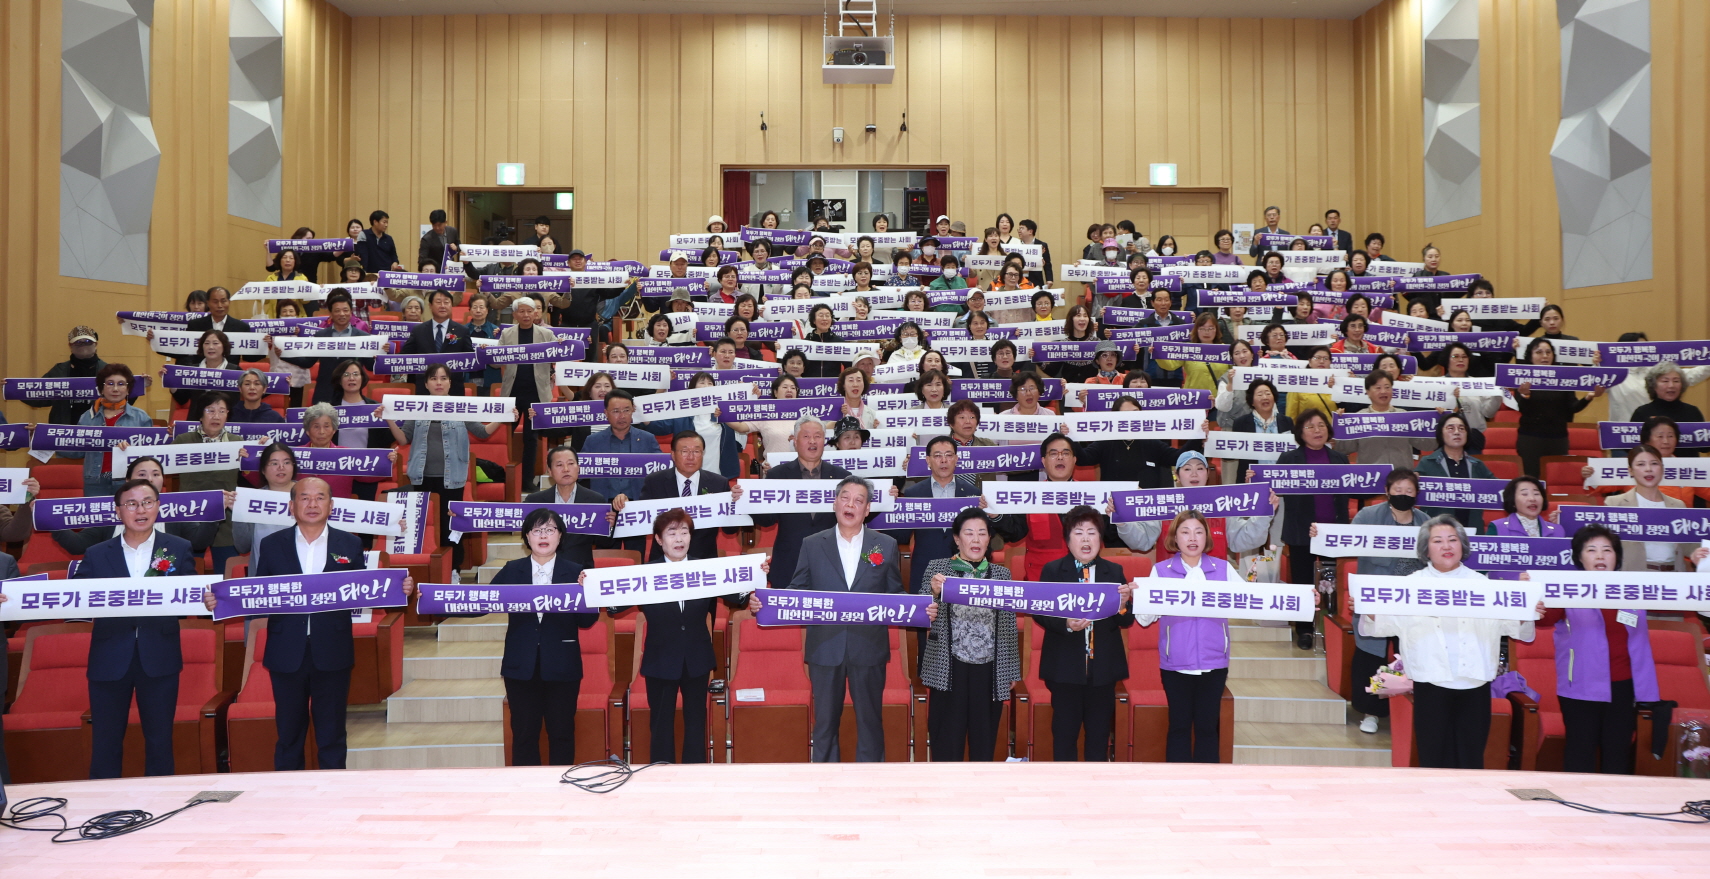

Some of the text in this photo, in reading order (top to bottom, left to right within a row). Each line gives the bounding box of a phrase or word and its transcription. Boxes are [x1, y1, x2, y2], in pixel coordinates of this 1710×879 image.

[493, 249, 523, 257] 존중받는
[390, 278, 458, 288] 대한민국의 태안!
[538, 280, 562, 289] 태안!
[1261, 292, 1288, 301] 태안!
[833, 303, 848, 311] 사회
[1482, 305, 1517, 313] 존중받는
[1522, 304, 1540, 313] 사회
[757, 327, 785, 339] 태안!
[1311, 332, 1327, 340] 사회
[160, 337, 258, 349] 모두가 사회
[284, 341, 379, 350] 모두가 존중받는 사회
[486, 348, 506, 356] 모두가
[493, 344, 574, 362] 대한민국의 정원 태안!
[817, 346, 850, 354] 존중받는
[1048, 350, 1081, 358] 대한민국의
[446, 358, 476, 369] 태안!
[674, 352, 702, 364] 태안!
[1617, 354, 1678, 363] 대한민국의 정원
[175, 369, 197, 377] 모두가
[182, 377, 224, 386] 대한민국의
[1580, 374, 1616, 387] 태안!
[26, 388, 72, 397] 대한민국의
[961, 383, 1002, 392] 모두가 행복한
[643, 400, 675, 414] 모두가
[728, 391, 749, 401] 사회
[1098, 393, 1119, 401] 모두가
[1149, 391, 1200, 407] 정원 태안!
[394, 401, 504, 413] 모두가 존중받는 사회
[544, 405, 590, 415] 모두가 행복한
[729, 404, 775, 414] 모두가 행복한
[551, 414, 594, 423] 대한민국의
[737, 405, 833, 421] 대한민국의 정원 태안!
[887, 417, 917, 427] 모두가
[1077, 419, 1194, 432] 모두가 존중받는 사회
[1338, 417, 1385, 426] 모두가 행복한
[77, 429, 102, 437] 행복한
[1004, 422, 1047, 433] 존중받는
[1346, 424, 1408, 434] 대한민국의 정원
[55, 434, 169, 447] 대한민국의 태안!
[267, 429, 304, 443] 태안!
[886, 436, 906, 447] 사회
[1216, 440, 1248, 451] 모두가
[176, 452, 230, 466] 존중받는
[316, 456, 379, 471] 정원 태안!
[595, 457, 619, 465] 행복한
[873, 456, 895, 468] 사회
[977, 452, 1035, 469] 정원 태안!
[625, 467, 642, 475] 정원
[1263, 470, 1315, 478] 모두가 행복한
[1272, 472, 1380, 488] 대한민국의 정원 태안!
[1419, 482, 1471, 493] 모두가 행복한
[749, 490, 790, 503] 모두가
[996, 492, 1095, 506] 모두가 존중받는
[1126, 494, 1184, 508] 모두가 행복한
[1215, 492, 1259, 512] 태안!
[1426, 492, 1497, 503] 대한민국의 정원
[53, 503, 87, 516] 모두가
[160, 499, 207, 518] 태안!
[464, 508, 523, 518] 모두가 행복한
[362, 511, 389, 526] 사회
[1575, 512, 1638, 522] 모두가 행복한
[1646, 525, 1669, 535] 정원
[1325, 535, 1416, 551] 모두가 존중받
[1470, 542, 1529, 553] 모두가 행복한
[1478, 554, 1557, 566] 대한민국의 정원
[600, 567, 752, 595] 모두가 존중받는 사회
[230, 582, 302, 599] 모두가 행복한
[242, 578, 391, 609] 대한민국의 정원 태안!
[434, 590, 499, 601] 모두가 행복한
[959, 584, 1024, 597] 모두가 행복한
[1545, 584, 1597, 598] 모두가
[1605, 585, 1677, 600] 존중받는
[21, 592, 81, 609] 모두가
[89, 589, 163, 607] 존중받는
[453, 593, 582, 612] 대한민국의 정원 태안!
[768, 596, 833, 609] 모두가 행복한
[968, 593, 1105, 612] 대한민국의 정원 태안!
[1150, 590, 1300, 611] 모두가 존중받는 사회
[1361, 588, 1526, 607] 모두가 존중받는 사회
[778, 604, 916, 622] 대한민국의 정원 태안!
